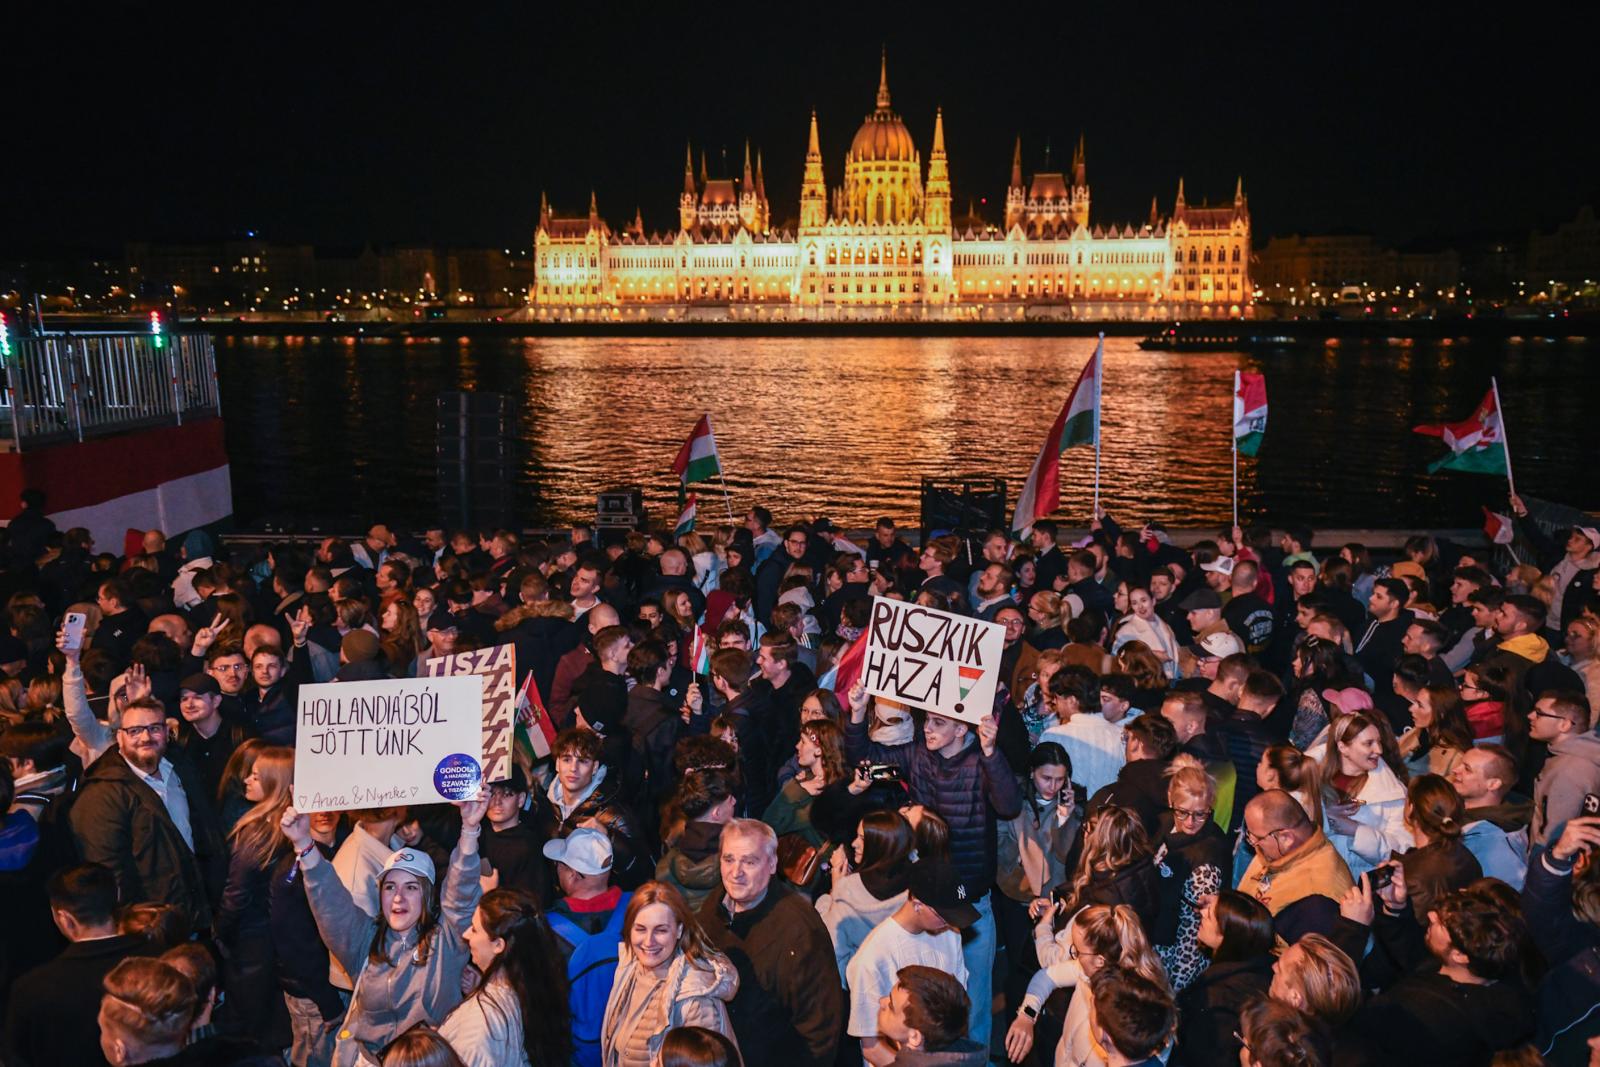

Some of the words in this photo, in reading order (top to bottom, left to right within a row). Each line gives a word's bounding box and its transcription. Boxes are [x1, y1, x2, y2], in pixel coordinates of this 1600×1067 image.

[869, 601, 989, 666] RUSZKIK
[426, 643, 512, 678] TISZA
[303, 687, 447, 726] HOLLANDIÁBÓL
[310, 728, 423, 755] JÖTTÜNK
[311, 792, 349, 809] Anna
[351, 785, 363, 805] &
[366, 786, 407, 806] Nynke
